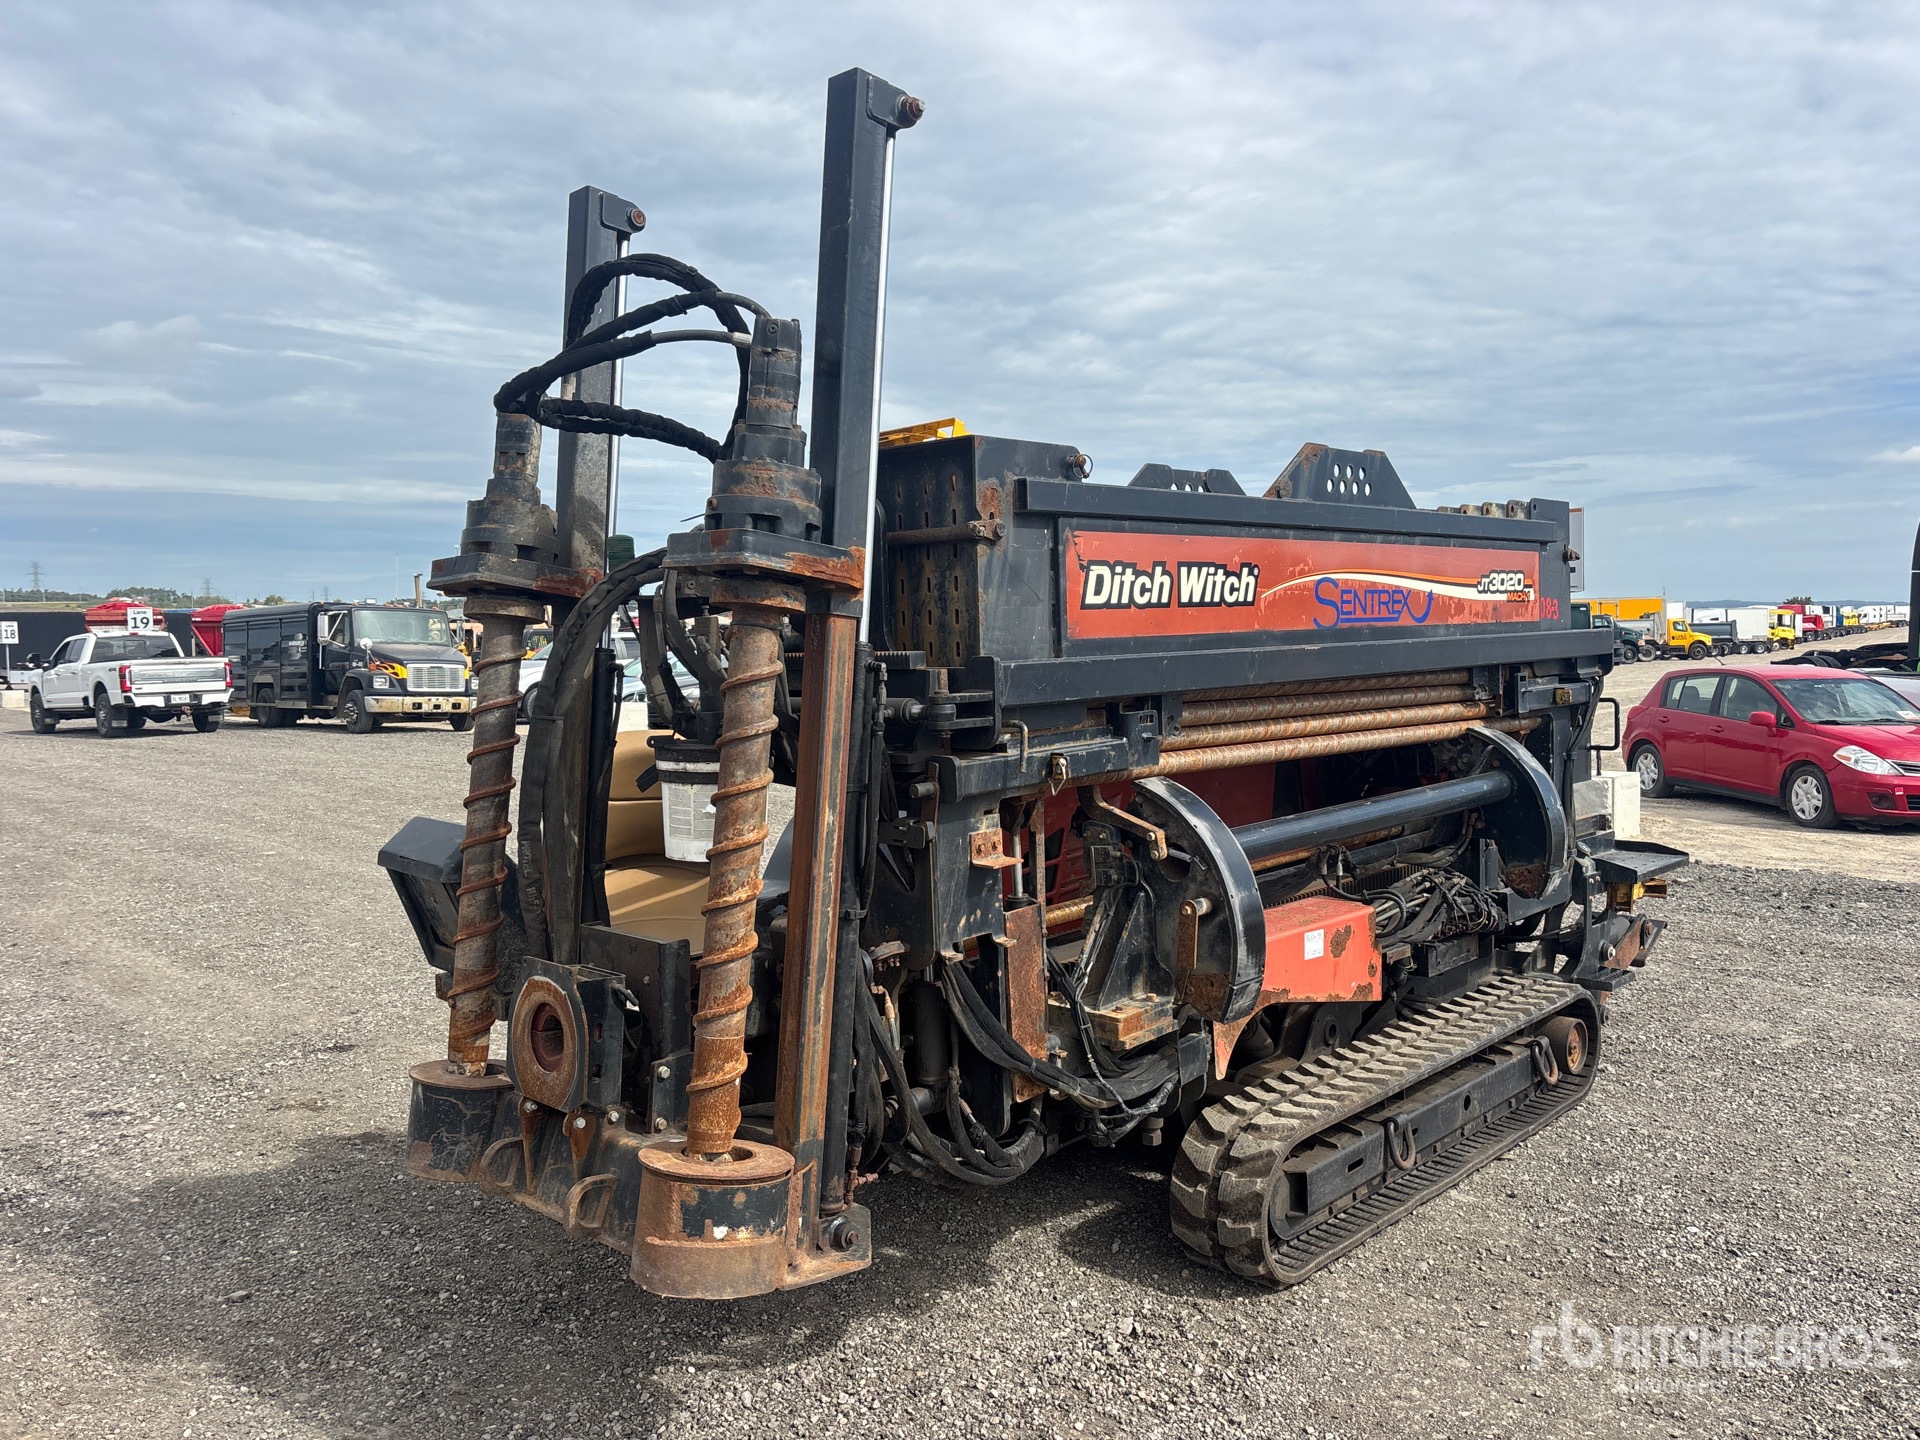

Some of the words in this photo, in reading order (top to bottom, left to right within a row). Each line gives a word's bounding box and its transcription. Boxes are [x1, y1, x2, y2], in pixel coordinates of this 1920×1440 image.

[1084, 565, 1169, 606] Ditch
[1179, 565, 1256, 605] Witch
[1477, 571, 1525, 593] JT3020
[131, 617, 150, 629] 19
[4, 629, 16, 639] 18
